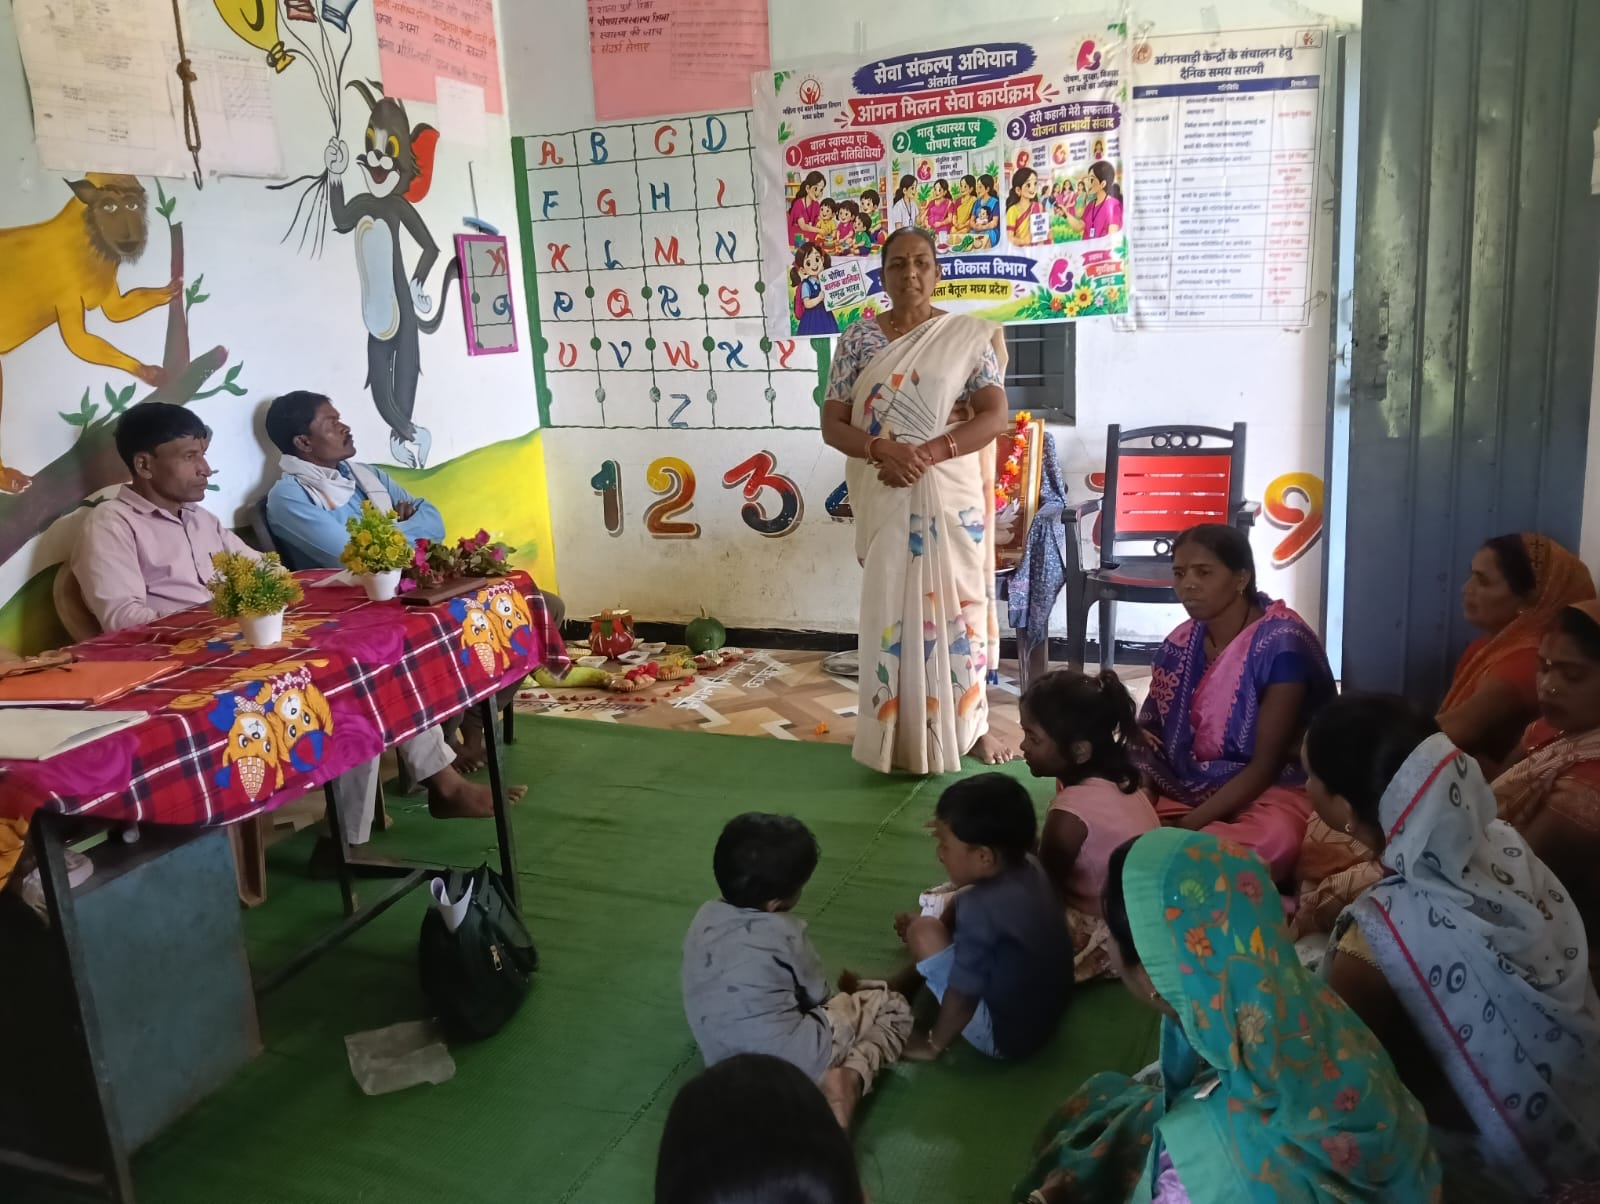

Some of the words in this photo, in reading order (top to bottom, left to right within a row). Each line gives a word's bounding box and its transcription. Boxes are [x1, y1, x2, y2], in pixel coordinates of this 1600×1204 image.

[874, 63, 902, 85] सेवा
[906, 56, 953, 78] संकल्प
[957, 48, 1018, 71] अभियान
[1154, 50, 1200, 67] आंगनवाड़ी
[1228, 49, 1238, 60] के
[1208, 67, 1232, 77] समय
[1234, 62, 1265, 76] सारणी
[927, 75, 958, 89] अंतर्गत
[857, 100, 897, 123] आंगन
[900, 93, 941, 118] मिलन
[945, 89, 974, 112] सेवा
[977, 82, 1035, 107] कार्यक्रम
[1029, 111, 1042, 124] मेरी
[936, 122, 966, 134] स्वास्थ्य
[967, 120, 981, 133] एवं
[1012, 122, 1020, 137] 3
[1032, 123, 1057, 137] योजना
[538, 141, 564, 165] A
[590, 132, 608, 164] B
[654, 125, 677, 155] C
[701, 117, 727, 151] D
[856, 131, 868, 145] एवं
[896, 136, 904, 150] 2
[953, 134, 977, 148] संवाद
[790, 150, 796, 163] 1
[804, 149, 839, 167] आनंदमयी
[542, 190, 559, 220] F
[597, 188, 617, 217] G
[649, 182, 671, 211] H
[654, 236, 685, 266] M
[715, 231, 737, 263] N
[954, 258, 990, 275] विकास
[993, 258, 1027, 277] विभाग
[970, 284, 986, 294] मध्य
[988, 282, 1008, 295] प्रदेश
[607, 288, 634, 317] Q
[658, 285, 681, 318] R
[718, 286, 741, 316] S
[608, 340, 632, 368] V
[663, 341, 699, 369] W
[718, 340, 749, 369] X
[778, 340, 796, 368] Y
[668, 393, 691, 428] Z
[591, 458, 622, 536] 1
[645, 456, 700, 538] 2
[722, 450, 803, 537] 3
[1263, 471, 1325, 569] 9
